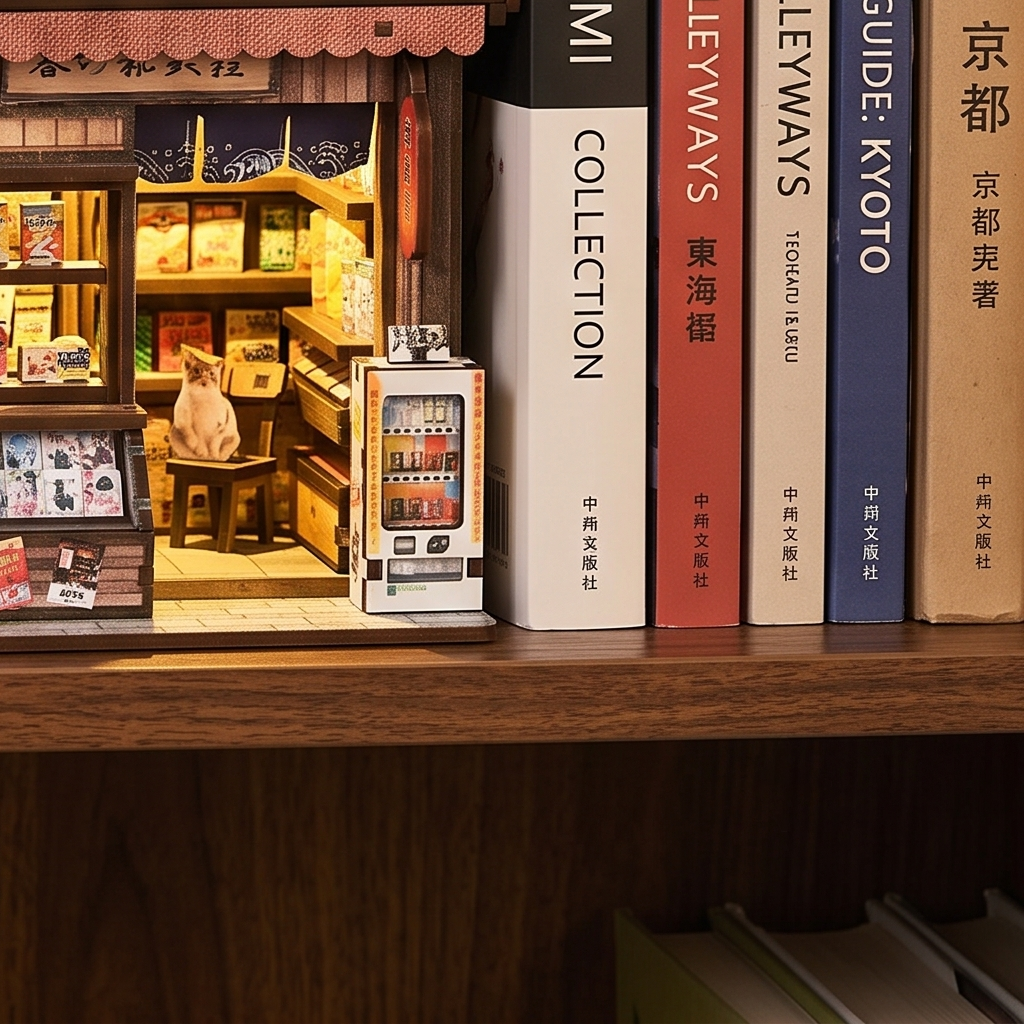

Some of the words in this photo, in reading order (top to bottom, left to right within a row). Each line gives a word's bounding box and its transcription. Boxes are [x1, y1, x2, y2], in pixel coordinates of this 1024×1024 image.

[961, 21, 1009, 133] 京都
[574, 130, 604, 378] COLLECTION
[860, 140, 891, 273] KYOTO
